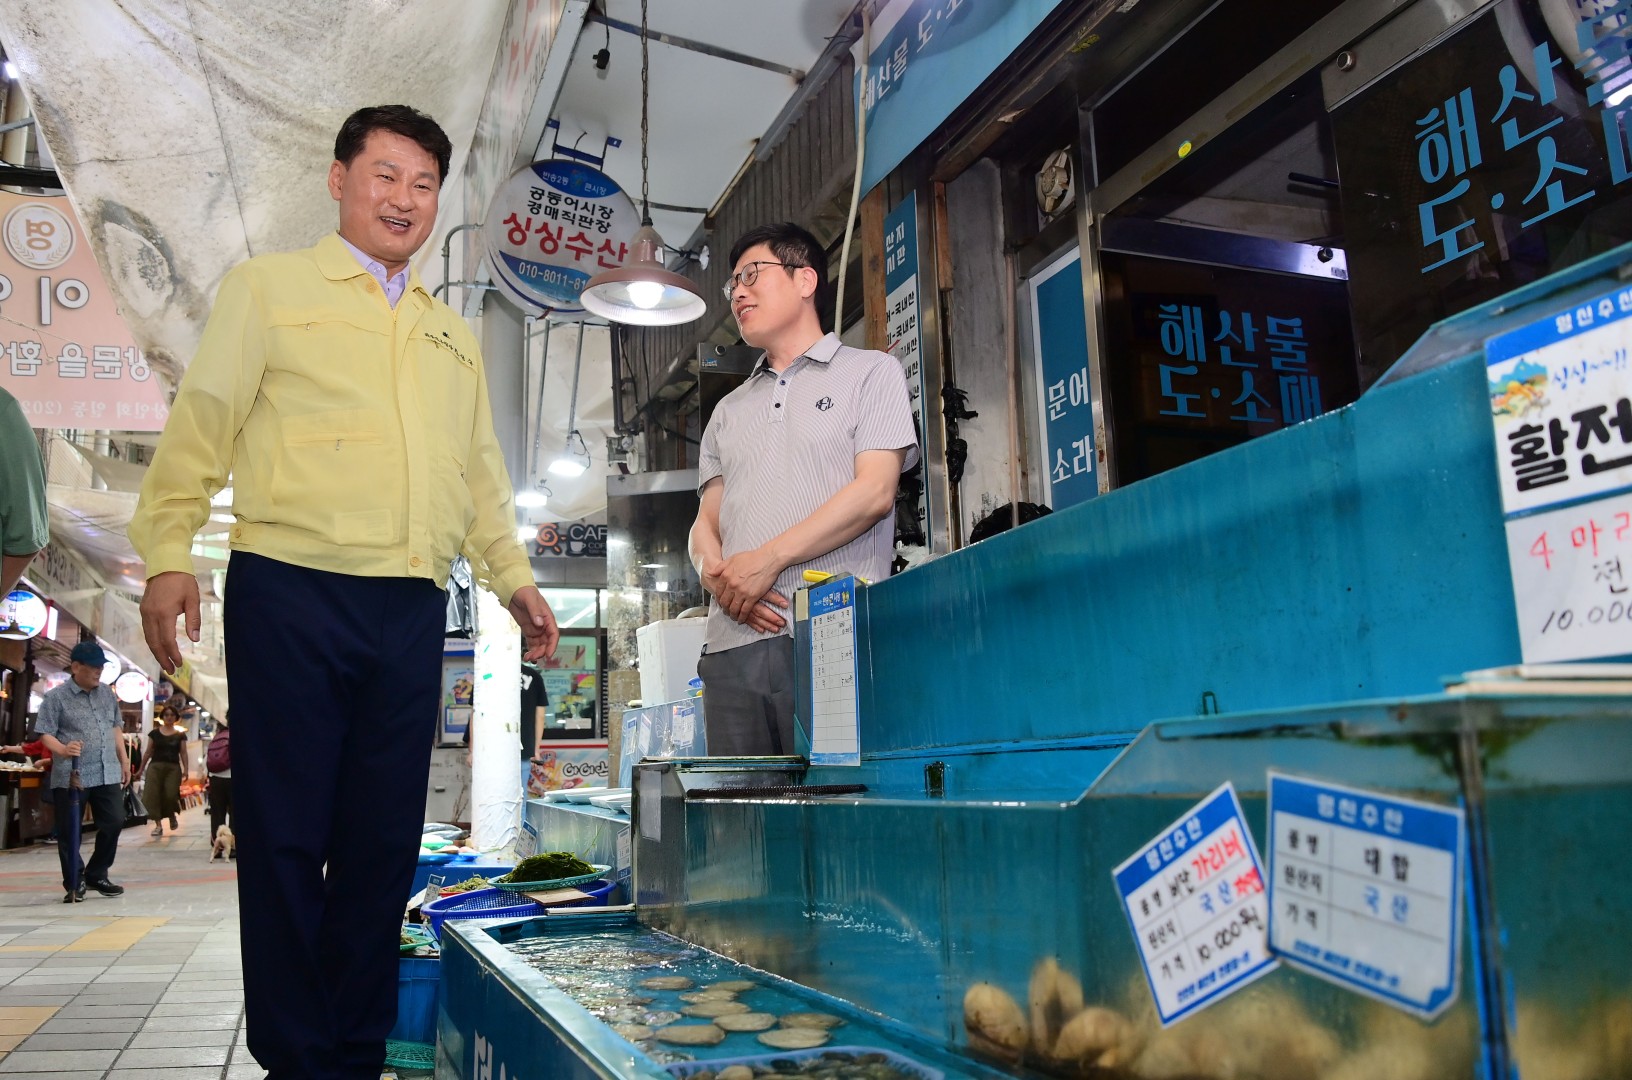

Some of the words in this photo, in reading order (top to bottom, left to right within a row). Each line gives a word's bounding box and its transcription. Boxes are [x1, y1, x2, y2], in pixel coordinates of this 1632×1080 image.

[529, 186, 615, 220] 공동어시장
[584, 182, 607, 196] 큰시장
[502, 212, 629, 269] 싱싱수산
[527, 200, 612, 234] 경매직판장
[1158, 303, 1308, 372] 해산물
[1048, 367, 1089, 421] 문어
[1159, 363, 1322, 424] 도·소매
[1053, 435, 1093, 484] 소라
[1508, 397, 1632, 492] 활전
[1529, 531, 1554, 570] 4
[1192, 829, 1246, 881] 가리비
